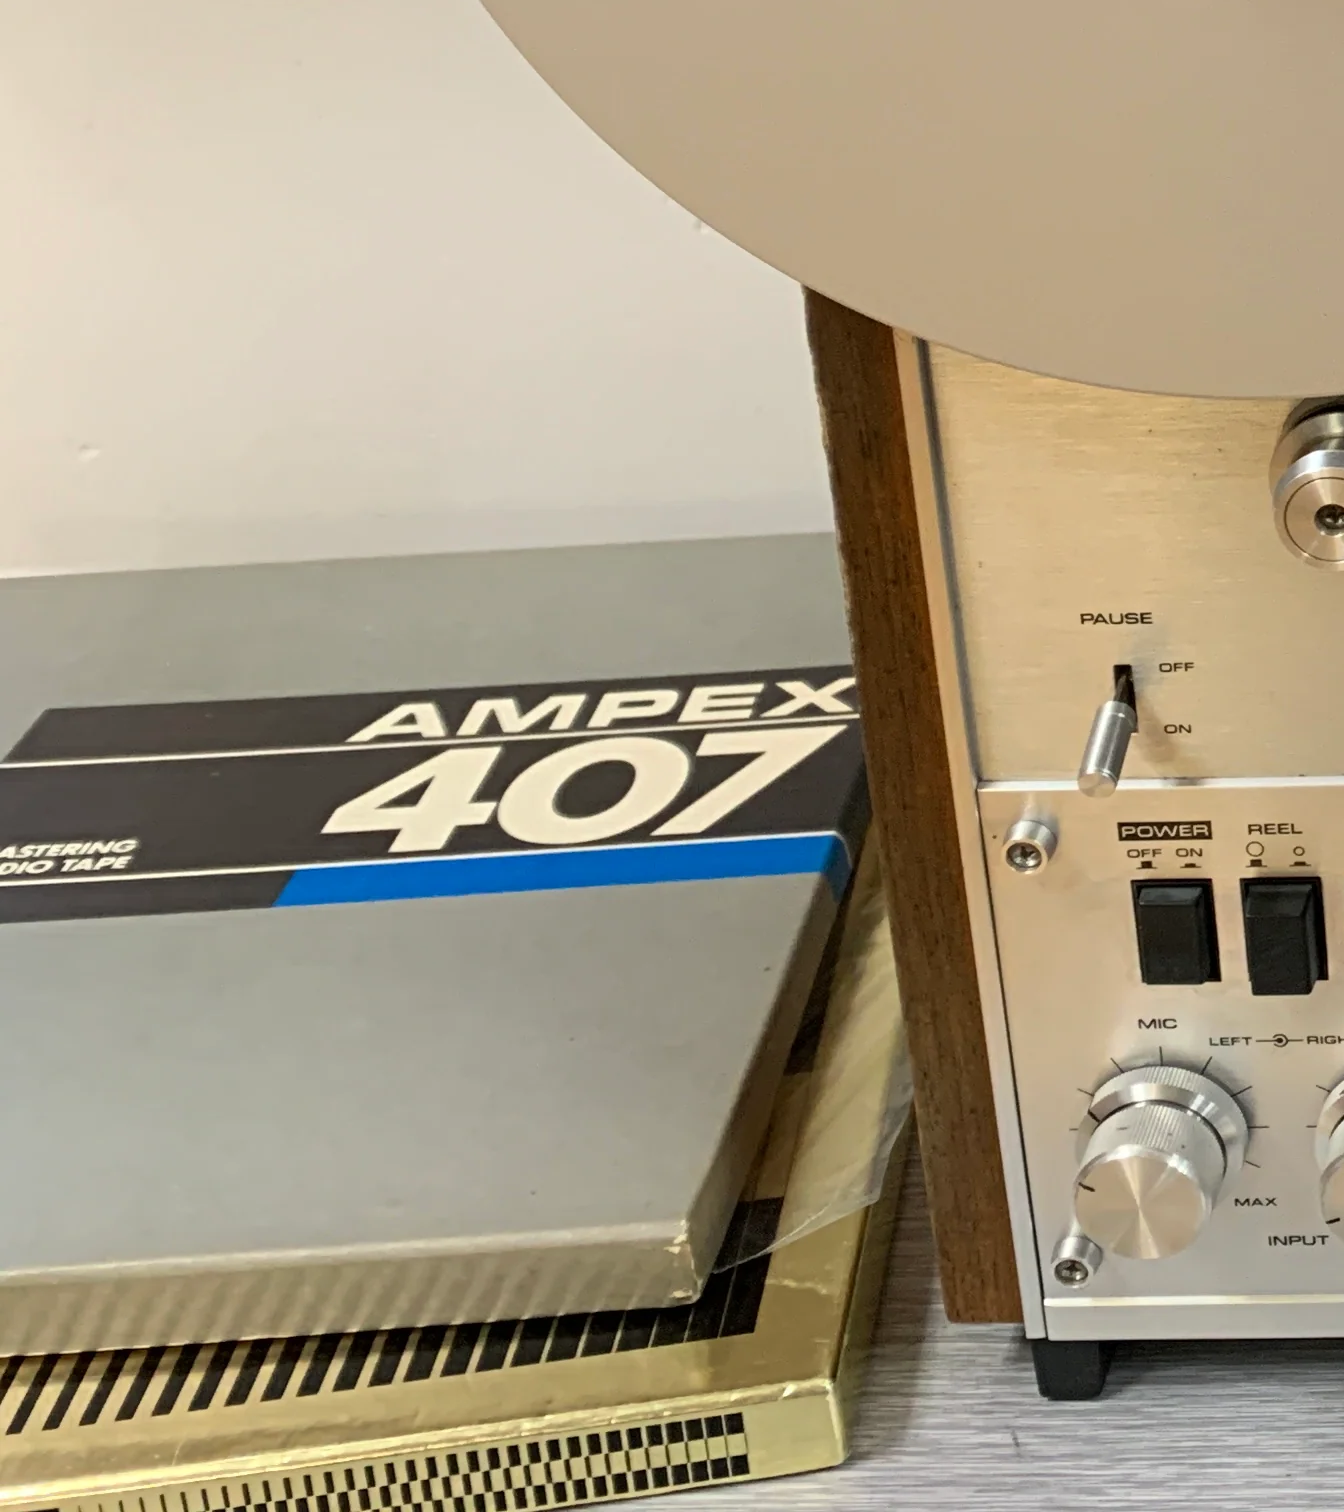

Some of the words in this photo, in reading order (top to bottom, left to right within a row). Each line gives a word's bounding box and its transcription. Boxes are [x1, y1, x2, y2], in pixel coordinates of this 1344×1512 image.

[1080, 612, 1154, 625] PAUSE
[1159, 662, 1195, 672] OFF
[345, 676, 857, 744] AMPEX
[1163, 723, 1192, 734] ON
[320, 724, 849, 854] 407
[1120, 824, 1210, 838] POWER
[1247, 823, 1303, 836] REEL
[1127, 848, 1162, 859] OFF
[1175, 848, 1203, 858] ON
[60, 855, 133, 873] TAPE
[1137, 1017, 1178, 1030] MIC
[1208, 1035, 1253, 1047] LEFT
[1234, 1197, 1278, 1207] MAX
[1267, 1234, 1330, 1247] INPUT
